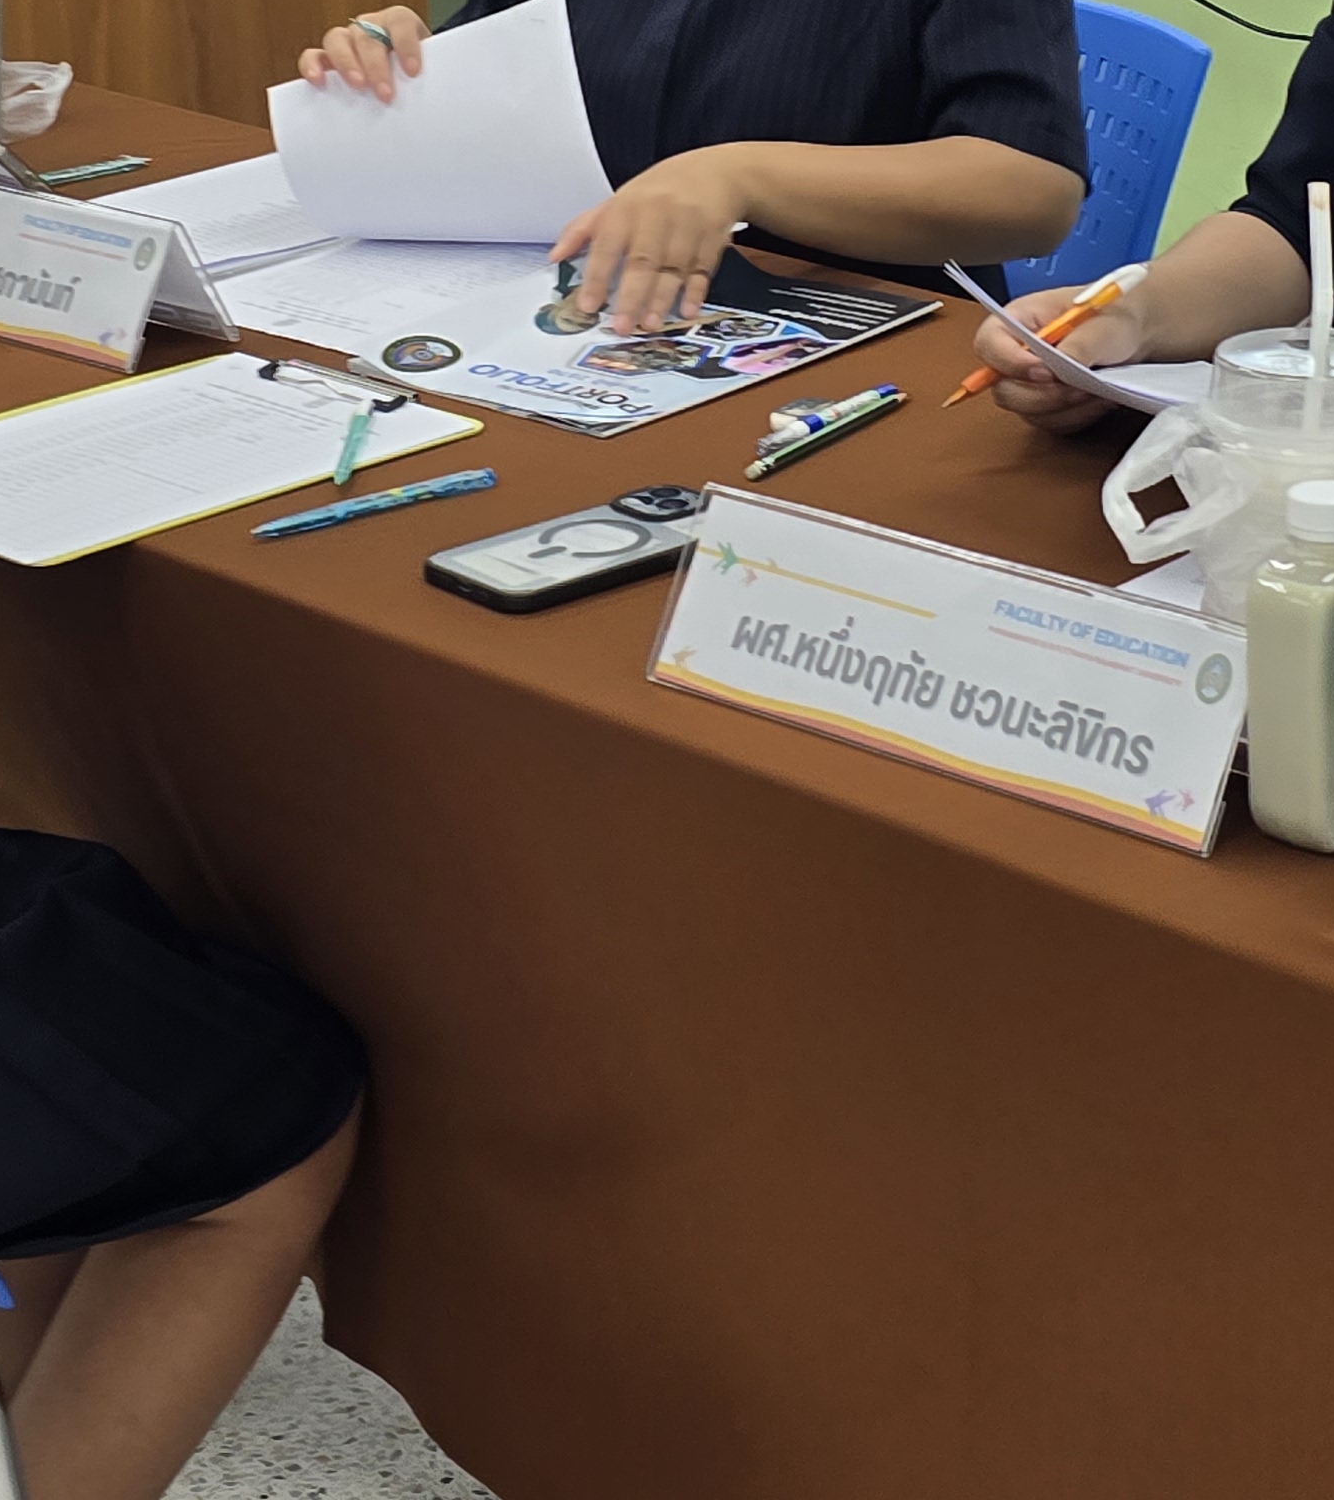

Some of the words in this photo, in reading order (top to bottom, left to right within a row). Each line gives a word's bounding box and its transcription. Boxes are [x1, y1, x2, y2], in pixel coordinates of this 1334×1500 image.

[468, 363, 654, 415] PORTFOLIO
[993, 599, 1067, 633] FACULTY
[1069, 620, 1095, 639] OF
[1093, 627, 1190, 668] EDUCATION
[730, 615, 946, 709] ผศ.หนึ่งฤทัย
[949, 679, 1156, 775] ชวนะลิขิกร
